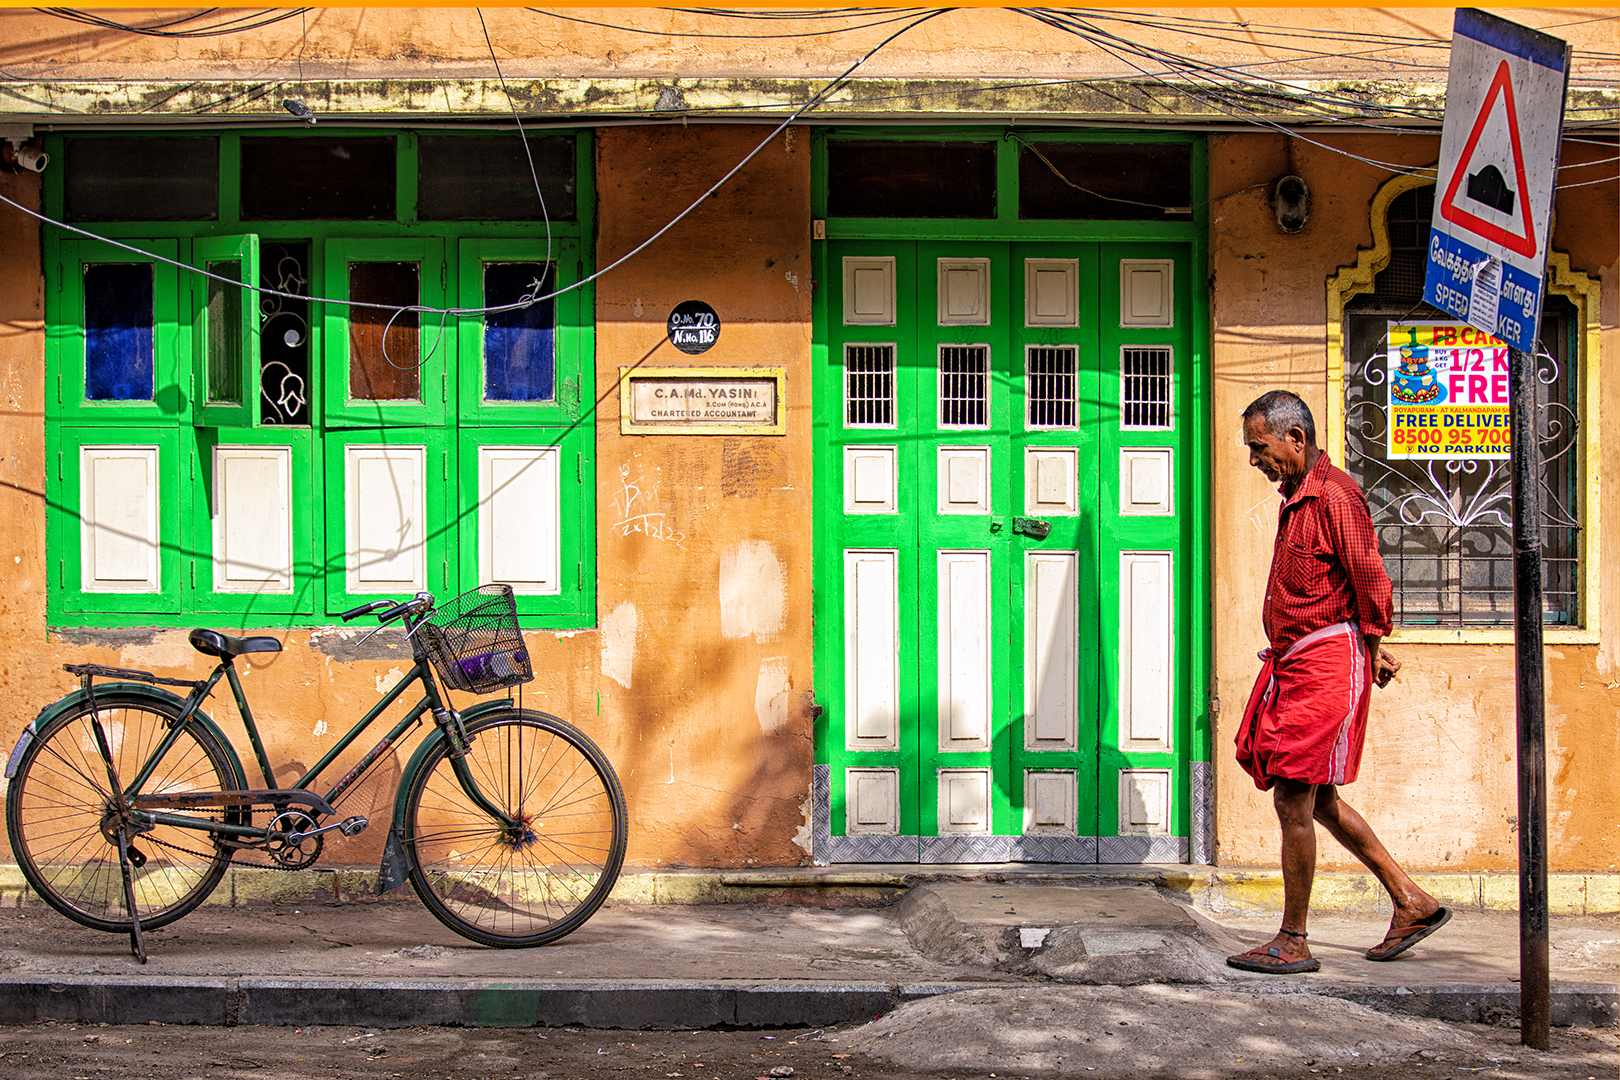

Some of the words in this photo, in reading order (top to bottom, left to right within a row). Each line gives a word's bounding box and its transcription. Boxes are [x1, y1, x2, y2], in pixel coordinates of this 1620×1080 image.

[1435, 283, 1468, 317] SPEED
[1500, 273, 1536, 318] ள்ளது
[695, 312, 714, 327] 70
[699, 330, 714, 343] 116
[1433, 327, 1457, 345] FB
[1461, 327, 1508, 345] CA
[1450, 349, 1485, 372] 1/2
[1493, 349, 1509, 372] K
[1449, 375, 1508, 403] FRE
[651, 410, 701, 418] CHARTERED
[704, 410, 757, 418] ACCOUNTANT
[1396, 414, 1438, 427] FREE
[1444, 414, 1510, 427] DELIVER
[1393, 429, 1442, 444] 8500
[1448, 429, 1472, 444] 95
[1477, 429, 1511, 444] 700
[1417, 445, 1440, 453] NO
[1445, 445, 1511, 453] PARKING
